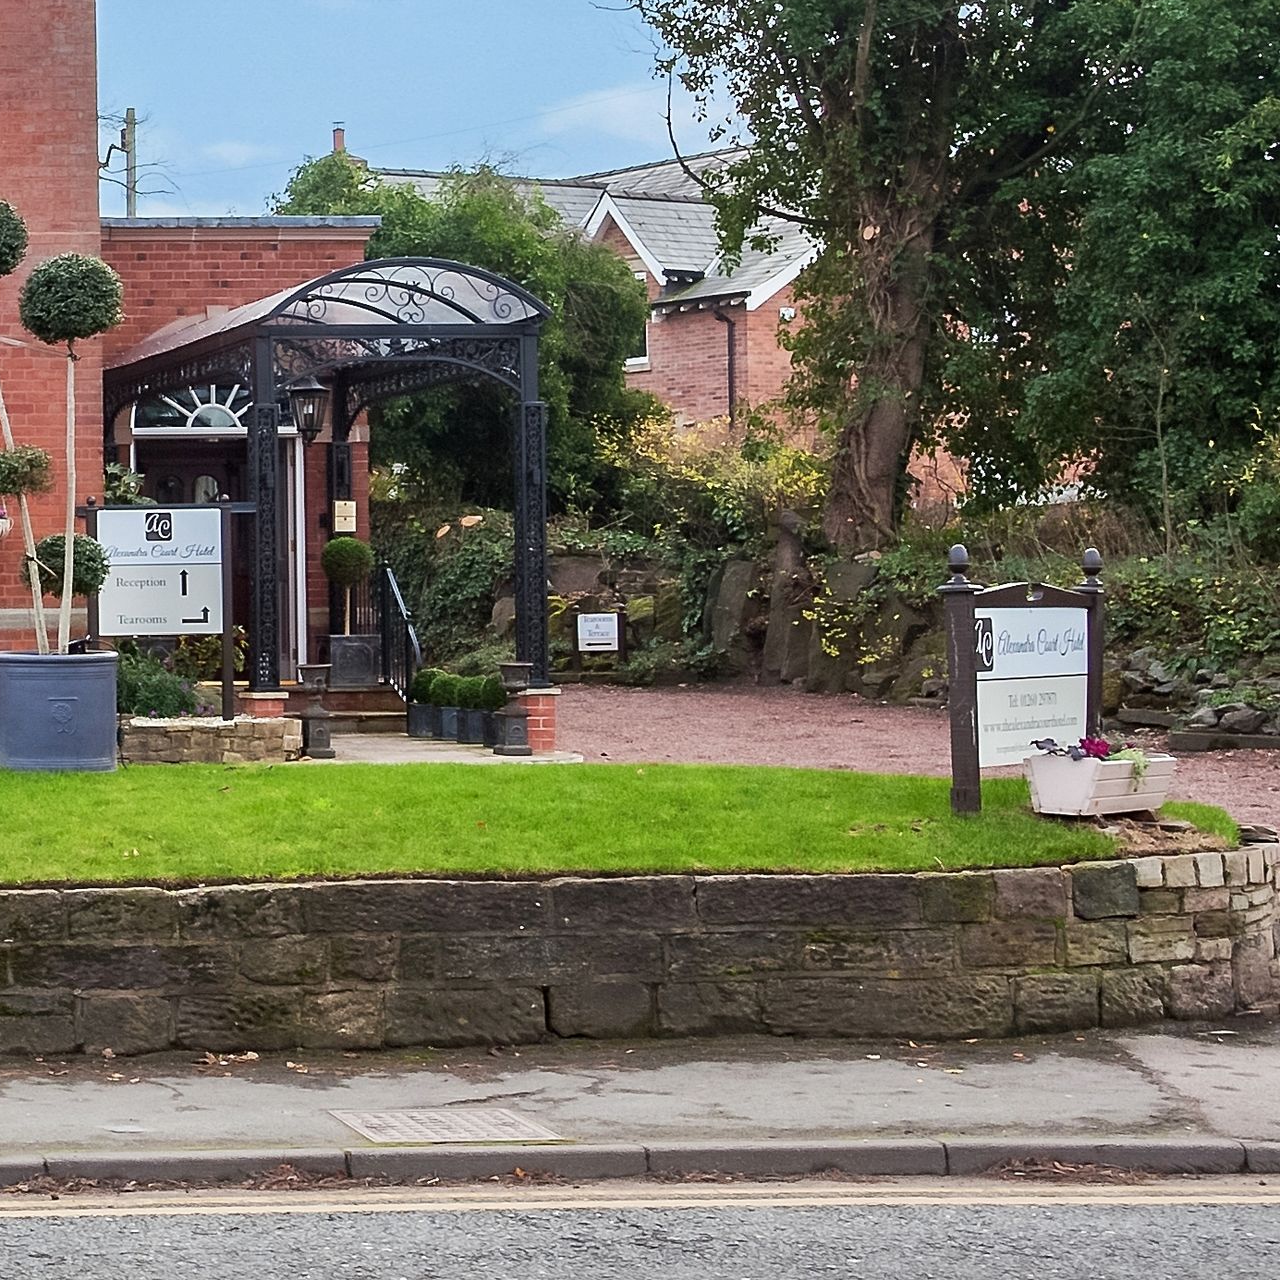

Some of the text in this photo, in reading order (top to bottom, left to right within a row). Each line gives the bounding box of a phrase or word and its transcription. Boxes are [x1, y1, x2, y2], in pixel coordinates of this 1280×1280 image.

[104, 543, 216, 559] Alexandra Court Hotel
[116, 577, 167, 589] Reception
[117, 614, 168, 625] Tearooms
[997, 627, 1086, 656] Alexandra Court Hotel
